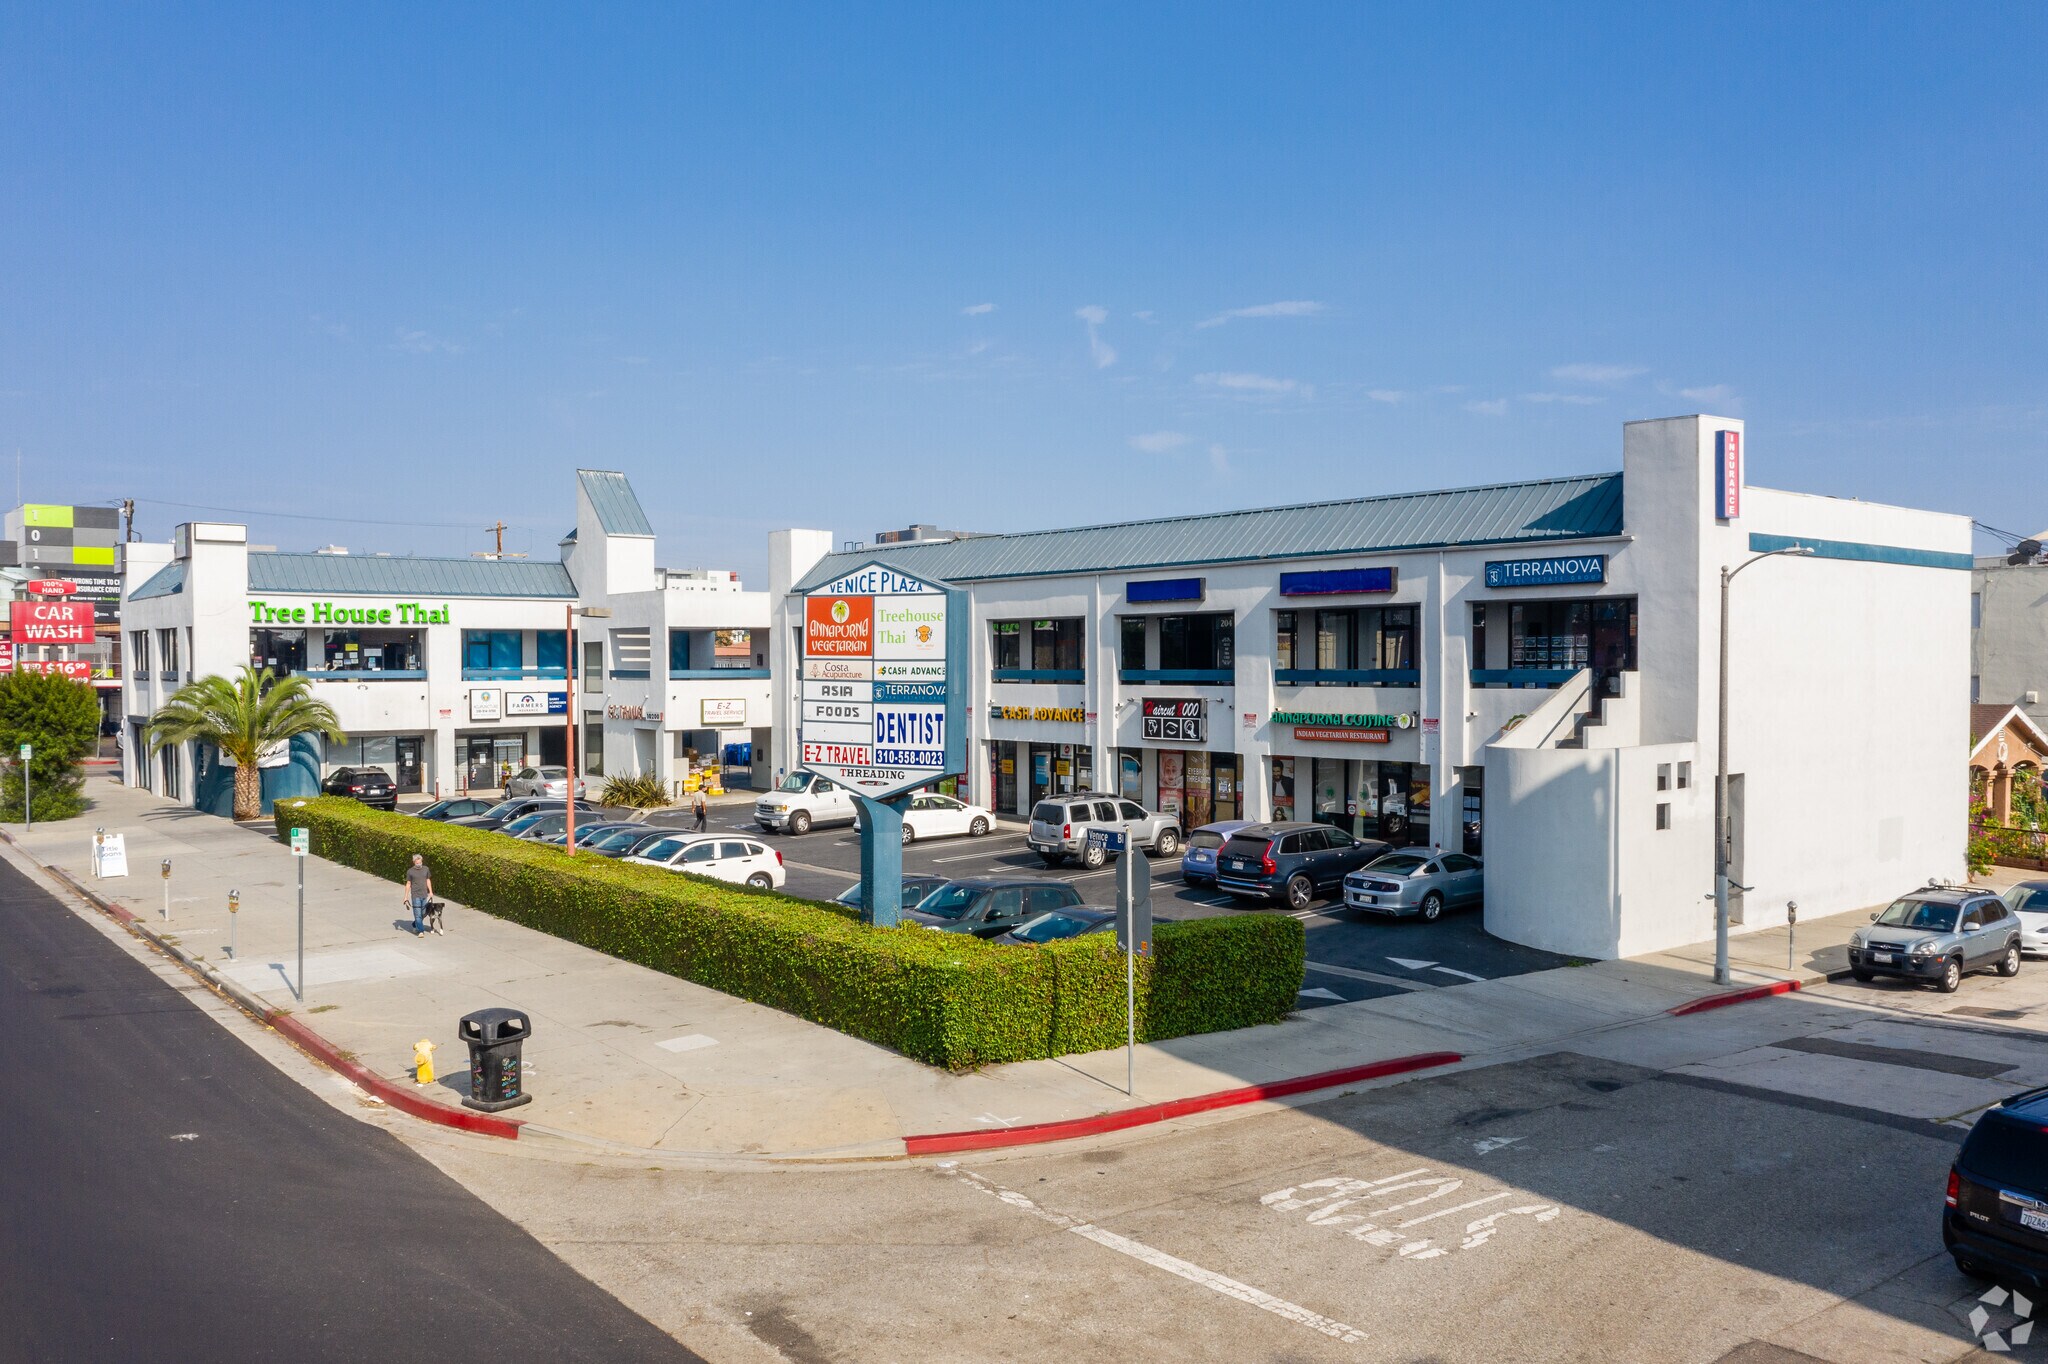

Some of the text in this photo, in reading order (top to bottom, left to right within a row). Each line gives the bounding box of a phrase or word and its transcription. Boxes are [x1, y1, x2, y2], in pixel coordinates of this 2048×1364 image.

[1504, 559, 1601, 577] TERRANOVA
[830, 572, 923, 593] VENICE PLAZA
[34, 606, 74, 620] CAR
[249, 601, 450, 624] Tree House Thai
[878, 608, 944, 622] Treehouse
[25, 625, 82, 638] WASH
[810, 618, 868, 639] ANNAPURNA
[878, 630, 906, 644] Thai
[812, 640, 867, 653] VEGETARIAN
[825, 662, 849, 672] Costa
[888, 666, 906, 676] CASH
[822, 672, 862, 680] Acupuncture
[822, 686, 853, 696] ASIA
[886, 685, 946, 696] TERRANOVA
[816, 706, 860, 718] FOODS
[1002, 706, 1031, 720] CASH
[1034, 708, 1084, 722] ADVANCE
[1144, 701, 1199, 716] Haircut 2000
[1272, 712, 1341, 726] ANNAPURNA
[1344, 714, 1394, 728] CUISINE
[877, 713, 944, 744] DENTIST
[804, 745, 870, 765] E-Z TRAVEL
[840, 768, 906, 780] THREADING
[1088, 830, 1108, 842] Venice
[1970, 1211, 1990, 1222] PILOT
